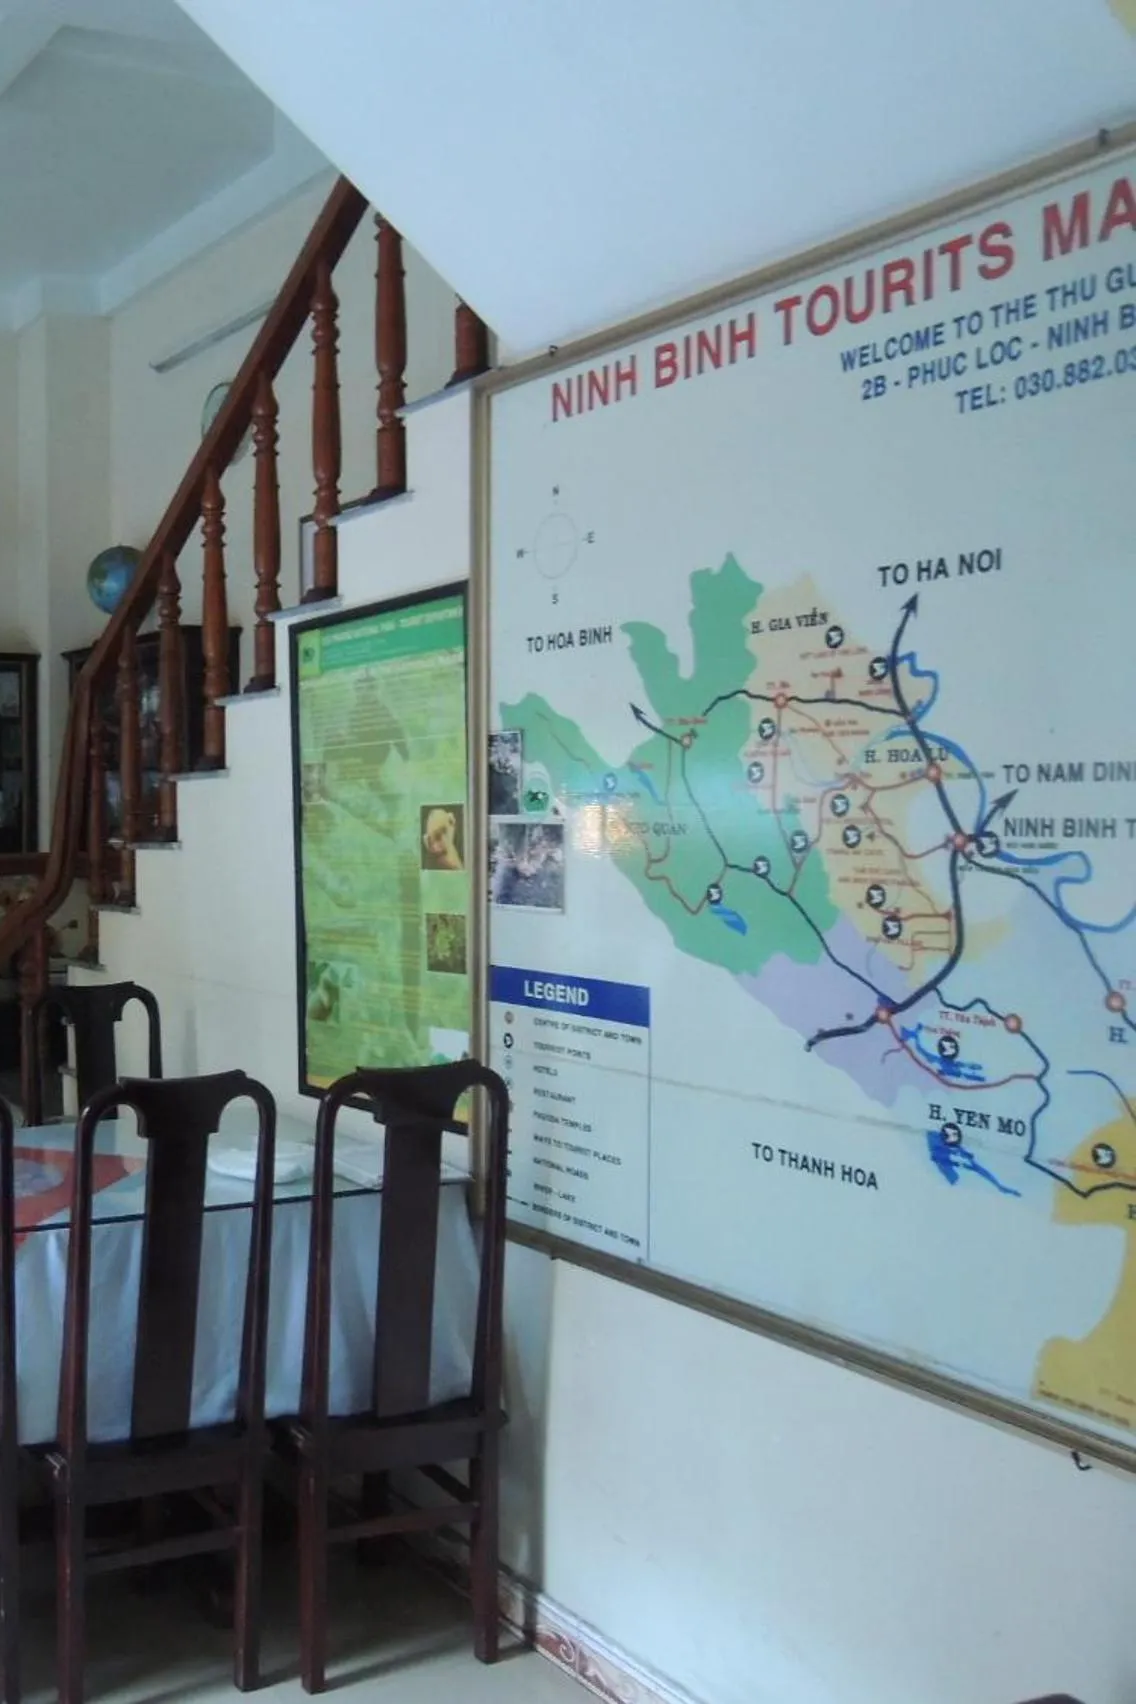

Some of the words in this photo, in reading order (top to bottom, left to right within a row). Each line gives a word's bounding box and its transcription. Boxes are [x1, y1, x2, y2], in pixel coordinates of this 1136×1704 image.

[552, 355, 637, 423] NINH
[654, 312, 756, 389] BINH
[773, 221, 1015, 346] TOURITS
[840, 322, 945, 372] WELCOME
[953, 310, 984, 339] TO
[990, 294, 1037, 328] THE
[1046, 273, 1097, 312] THU
[861, 375, 888, 401] 2B
[907, 351, 968, 389] PHUC
[975, 336, 1023, 370] LOC
[1047, 309, 1109, 350] NINH
[955, 384, 1007, 414] TEL:
[877, 563, 909, 588] TO
[917, 558, 949, 582] HA
[959, 548, 1002, 576] NOI
[526, 636, 545, 653] TO
[547, 631, 574, 651] HOA
[579, 625, 613, 647] BINH
[887, 748, 922, 763] HOA
[1002, 764, 1030, 784] TO
[1037, 761, 1084, 783] NAM
[1004, 817, 1055, 838] NINH
[1063, 817, 1117, 839] BINH
[524, 980, 590, 1006] LEGEND
[928, 1103, 947, 1122] H.
[953, 1108, 992, 1129] YEN
[997, 1117, 1026, 1137] MO
[751, 1142, 774, 1163] TO
[778, 1148, 835, 1180] THANH
[841, 1164, 879, 1190] HOA
